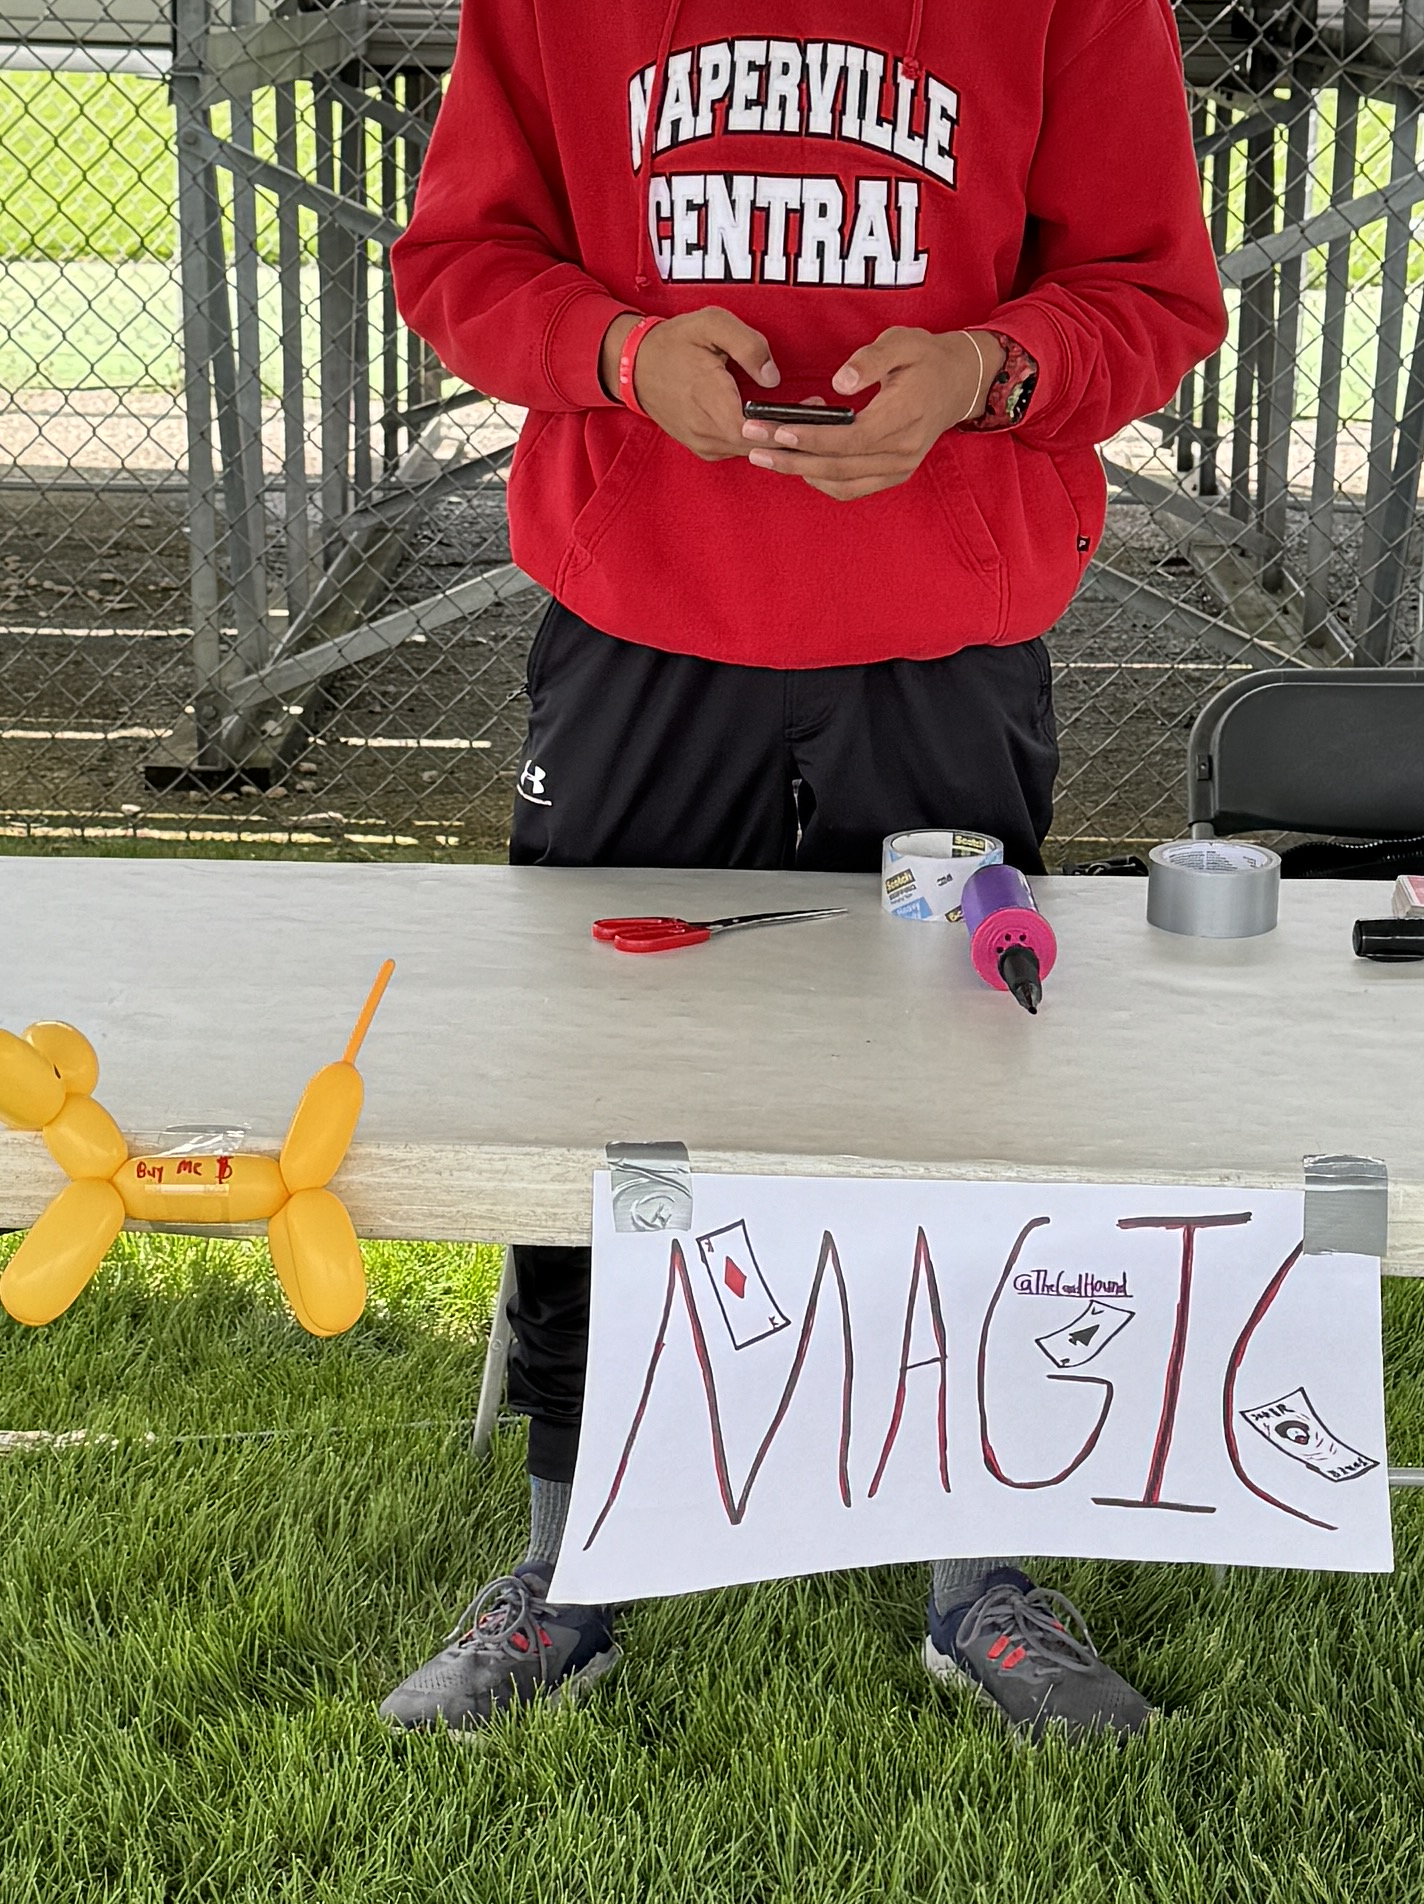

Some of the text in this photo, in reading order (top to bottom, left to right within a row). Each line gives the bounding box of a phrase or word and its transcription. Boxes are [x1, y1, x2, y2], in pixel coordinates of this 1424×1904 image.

[648, 174, 929, 285] CENTRAL
[885, 870, 915, 891] Scotch
[583, 1212, 1338, 1550] MAGIC
